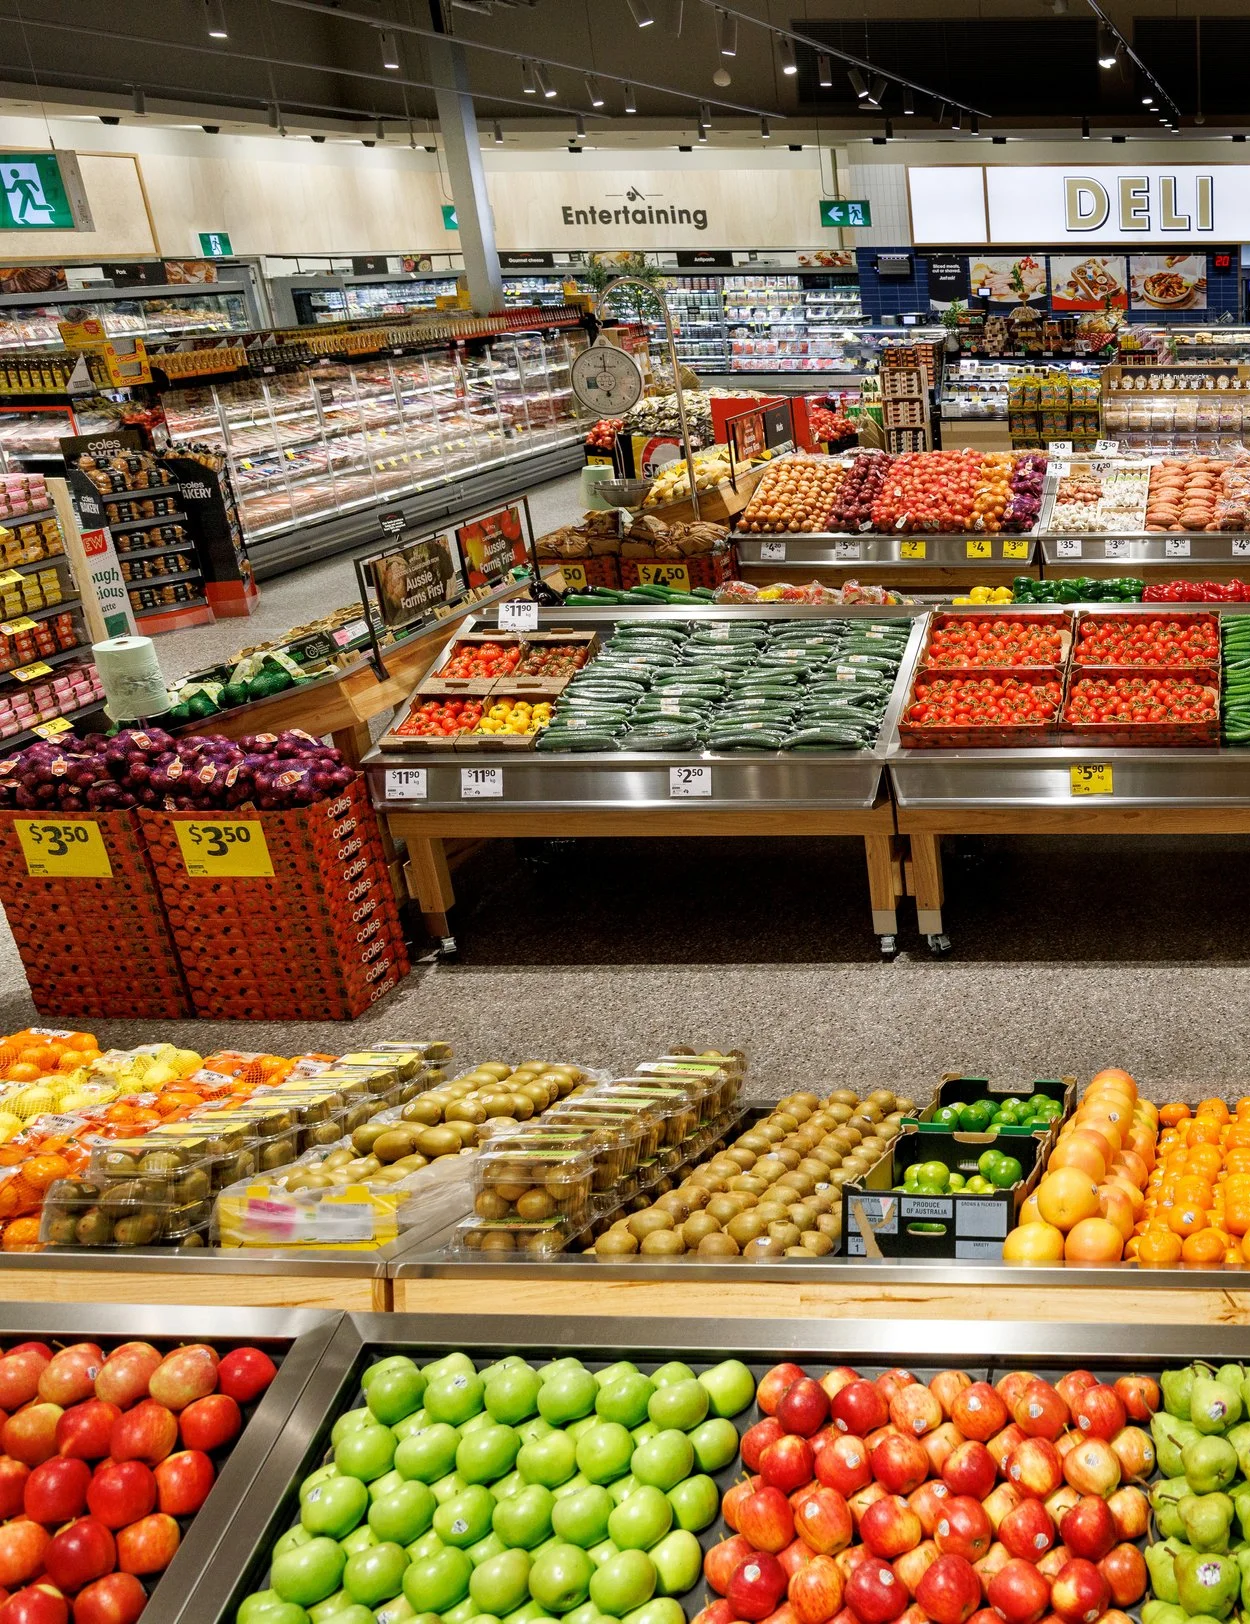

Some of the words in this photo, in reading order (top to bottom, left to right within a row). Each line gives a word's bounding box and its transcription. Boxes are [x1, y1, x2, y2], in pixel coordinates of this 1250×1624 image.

[1064, 176, 1214, 231] DELI
[562, 205, 708, 230] Entertaining
[1216, 255, 1230, 267] 20
[87, 438, 121, 451] coles
[180, 481, 205, 490] coles
[80, 501, 100, 514] BAKERY
[81, 495, 94, 503] coles
[483, 539, 506, 557] Aussie
[908, 541, 917, 550] $2
[973, 541, 985, 552] $4
[1060, 540, 1073, 549] $35
[480, 558, 501, 574] Farms
[500, 550, 516, 565] First
[406, 570, 433, 591] Aussie
[401, 591, 427, 609] Farms
[427, 581, 445, 597] First
[327, 795, 352, 818] coles
[333, 816, 357, 840] coles
[338, 837, 362, 860] coles
[343, 857, 367, 881] coles
[348, 877, 372, 901] coles
[352, 898, 376, 922] coles
[356, 918, 381, 942] coles
[361, 938, 385, 963] coles
[365, 957, 390, 983] coles
[371, 978, 394, 1001] coles
